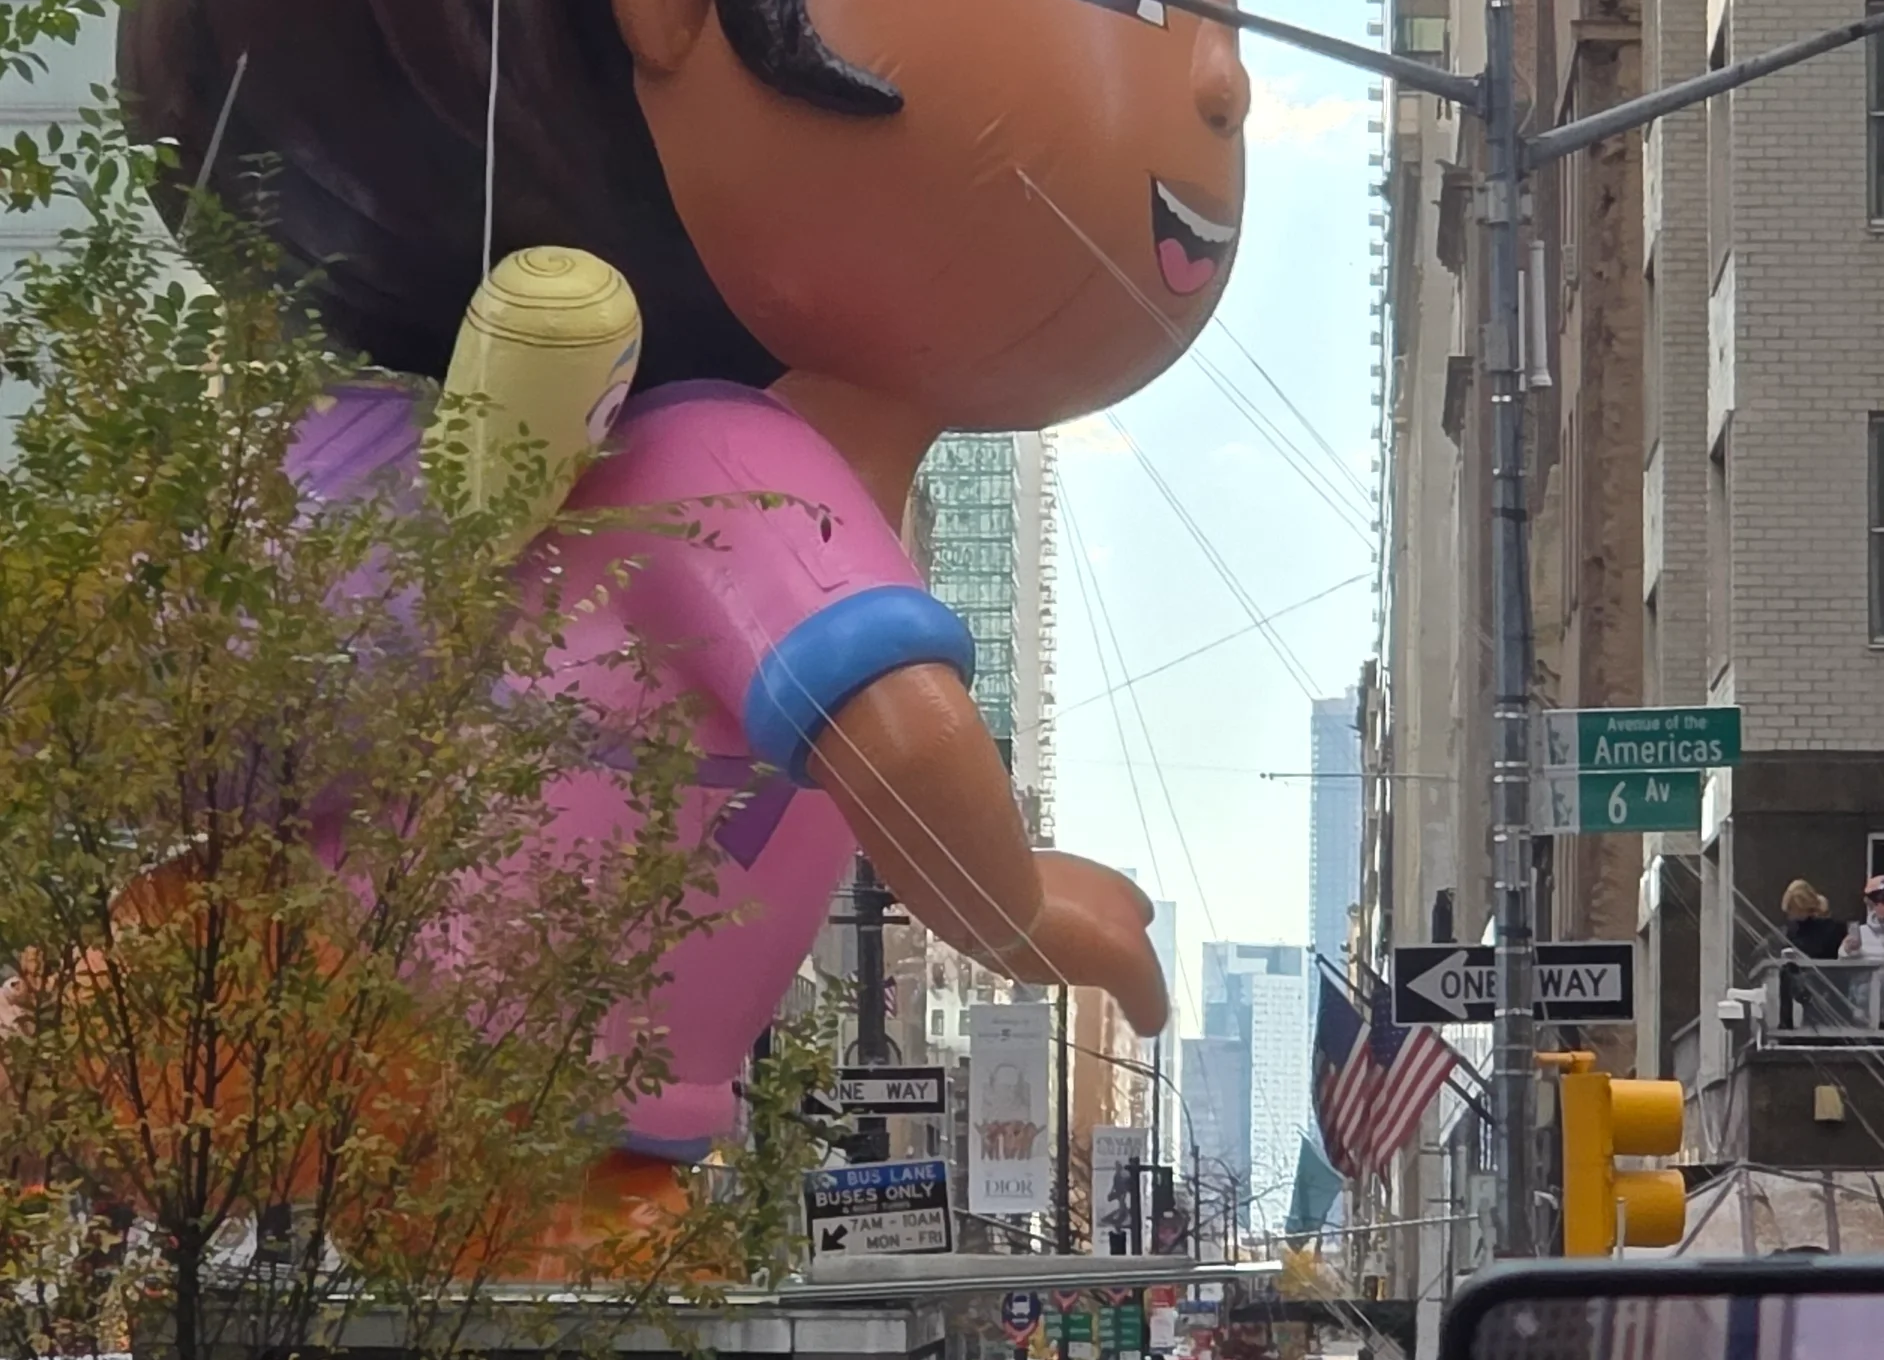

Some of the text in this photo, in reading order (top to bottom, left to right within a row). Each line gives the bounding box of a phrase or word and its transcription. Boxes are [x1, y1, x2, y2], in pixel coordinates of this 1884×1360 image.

[1607, 715, 1707, 732] Avenue of the
[1594, 734, 1723, 766] Americas
[1608, 778, 1671, 824] 6 Av
[1440, 968, 1607, 1000] ONE WAY
[827, 1082, 929, 1101] ONE WAY
[847, 1165, 937, 1186] BUS LANE
[985, 1179, 1033, 1193] DIOR
[815, 1182, 935, 1207] BUSES ONLY
[850, 1217, 883, 1232] 7AM
[902, 1211, 941, 1228] 10AM
[866, 1234, 900, 1249] MON
[919, 1231, 943, 1245] FRI
